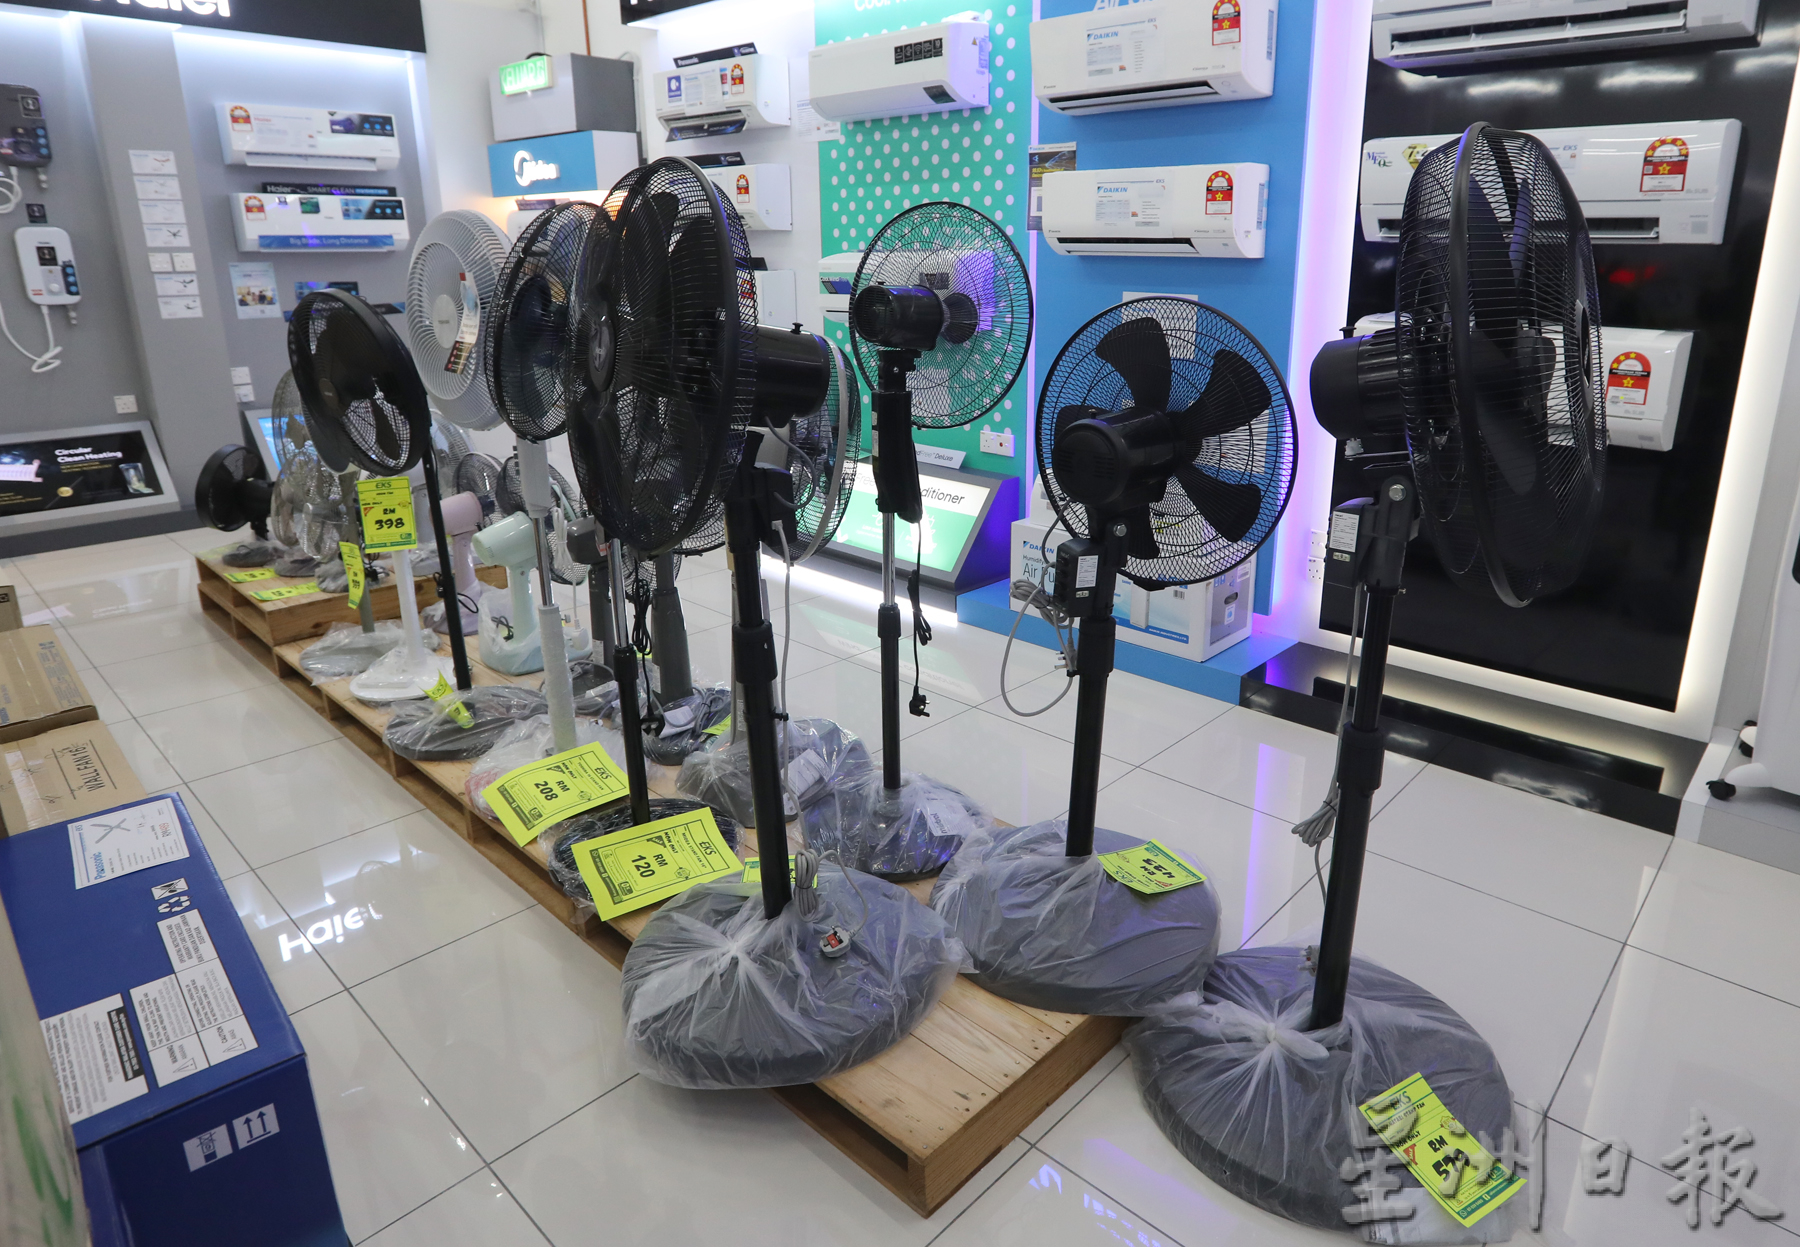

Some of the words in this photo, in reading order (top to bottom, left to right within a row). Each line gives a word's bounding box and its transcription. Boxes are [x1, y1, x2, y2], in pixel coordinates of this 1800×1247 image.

[1093, 31, 1119, 40] DAIKIN
[267, 184, 292, 193] Haier
[307, 186, 331, 194] SMART
[289, 237, 301, 246] Big
[322, 237, 340, 246] Long
[340, 237, 369, 245] Distance
[54, 447, 93, 456] Circular
[57, 454, 85, 463] Clean
[85, 450, 123, 461] Heating
[934, 453, 954, 462] Deluxe
[375, 481, 392, 489] EKS
[374, 517, 405, 530] 398
[1023, 562, 1038, 579] Air
[72, 755, 95, 771] FAN
[594, 767, 613, 780] EKS
[81, 769, 105, 792] WALL
[556, 780, 571, 793] RM
[534, 780, 559, 802] 208
[669, 843, 679, 854] ONLY
[699, 841, 717, 856] EKS
[90, 852, 106, 880] Panasonic
[631, 854, 656, 878] 120
[653, 853, 669, 868] RM
[1140, 865, 1157, 876] RM
[215, 1025, 228, 1044] CAUTION
[166, 1044, 178, 1064] WARNING
[1391, 1090, 1412, 1111] EKS
[1416, 1102, 1425, 1110] FAN
[1407, 1130, 1421, 1143] ONLY
[1427, 1135, 1448, 1153] RM
[1432, 1148, 1470, 1183] 579
